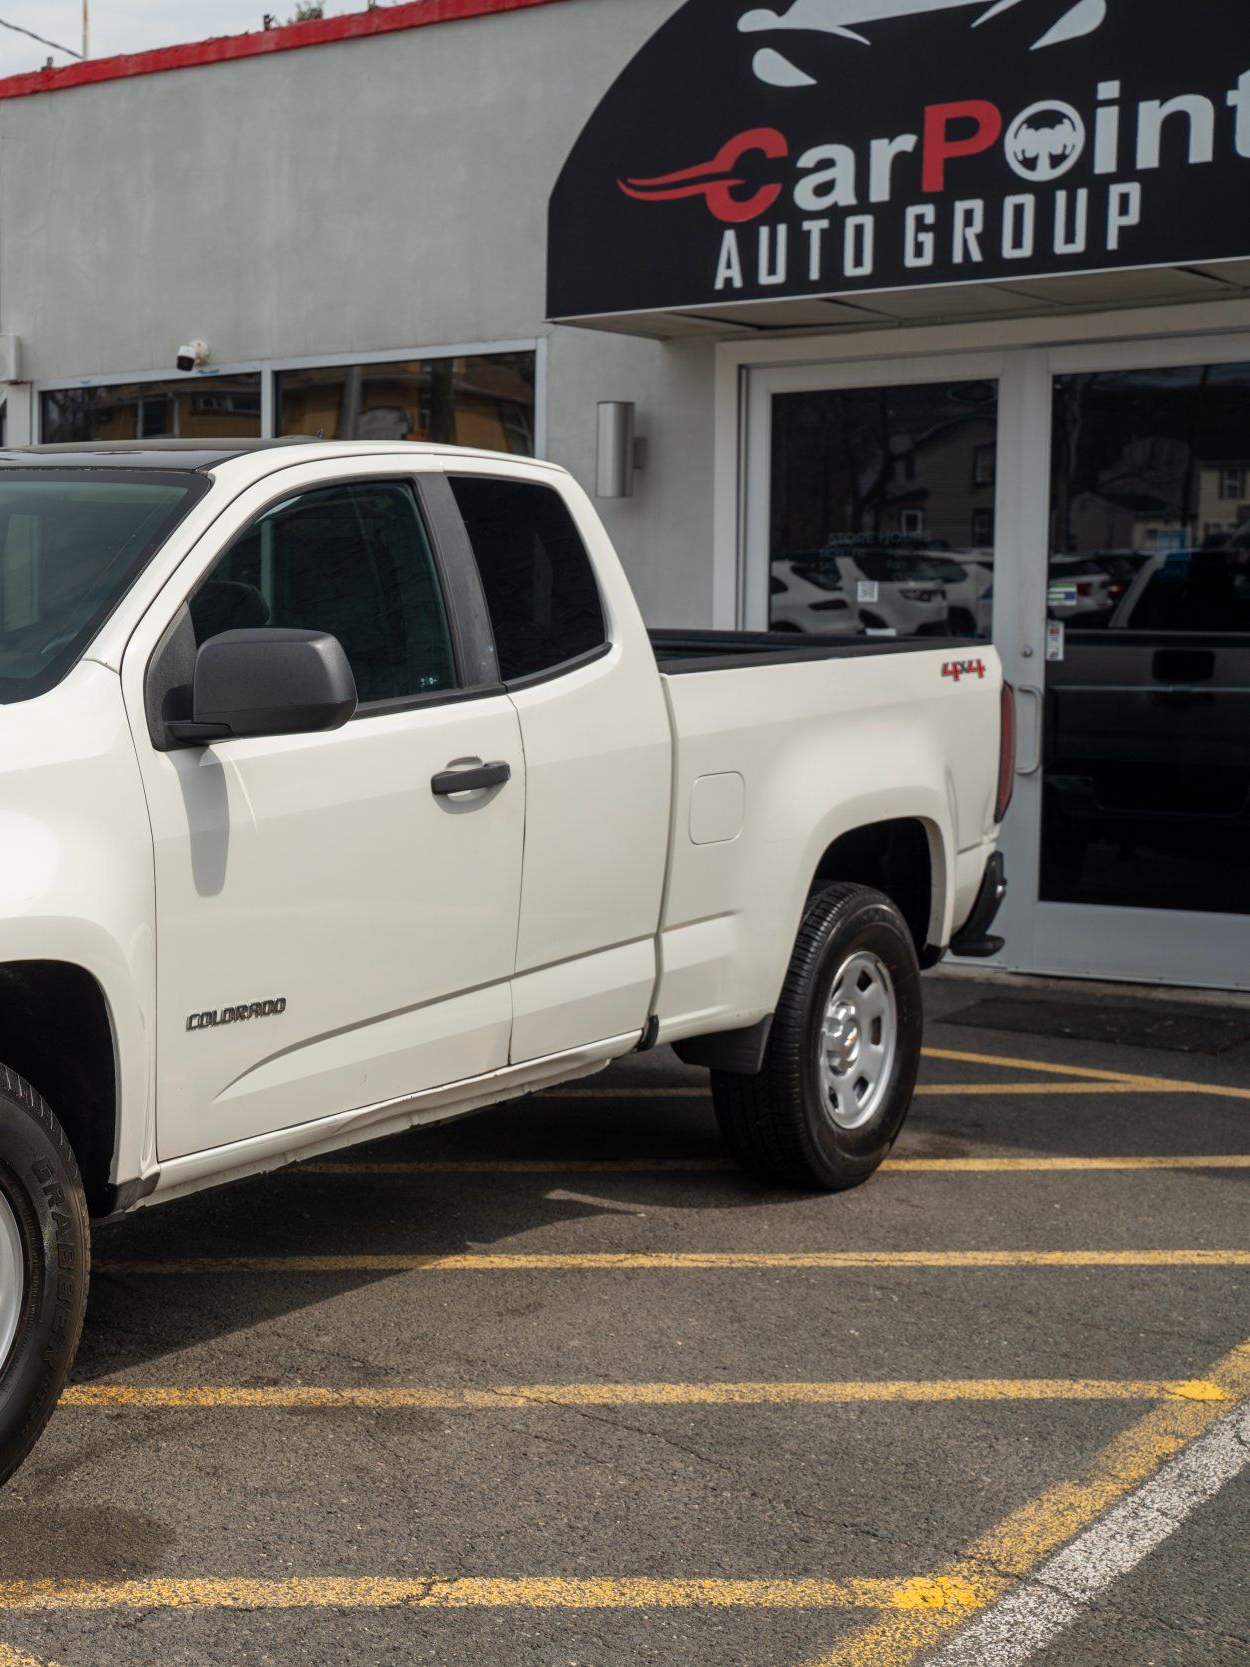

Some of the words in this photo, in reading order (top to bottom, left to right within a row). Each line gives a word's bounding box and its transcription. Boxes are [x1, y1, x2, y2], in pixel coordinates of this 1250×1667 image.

[714, 214, 874, 290] AUTO
[904, 182, 1141, 268] GROUP
[186, 997, 287, 1032] COLORADO
